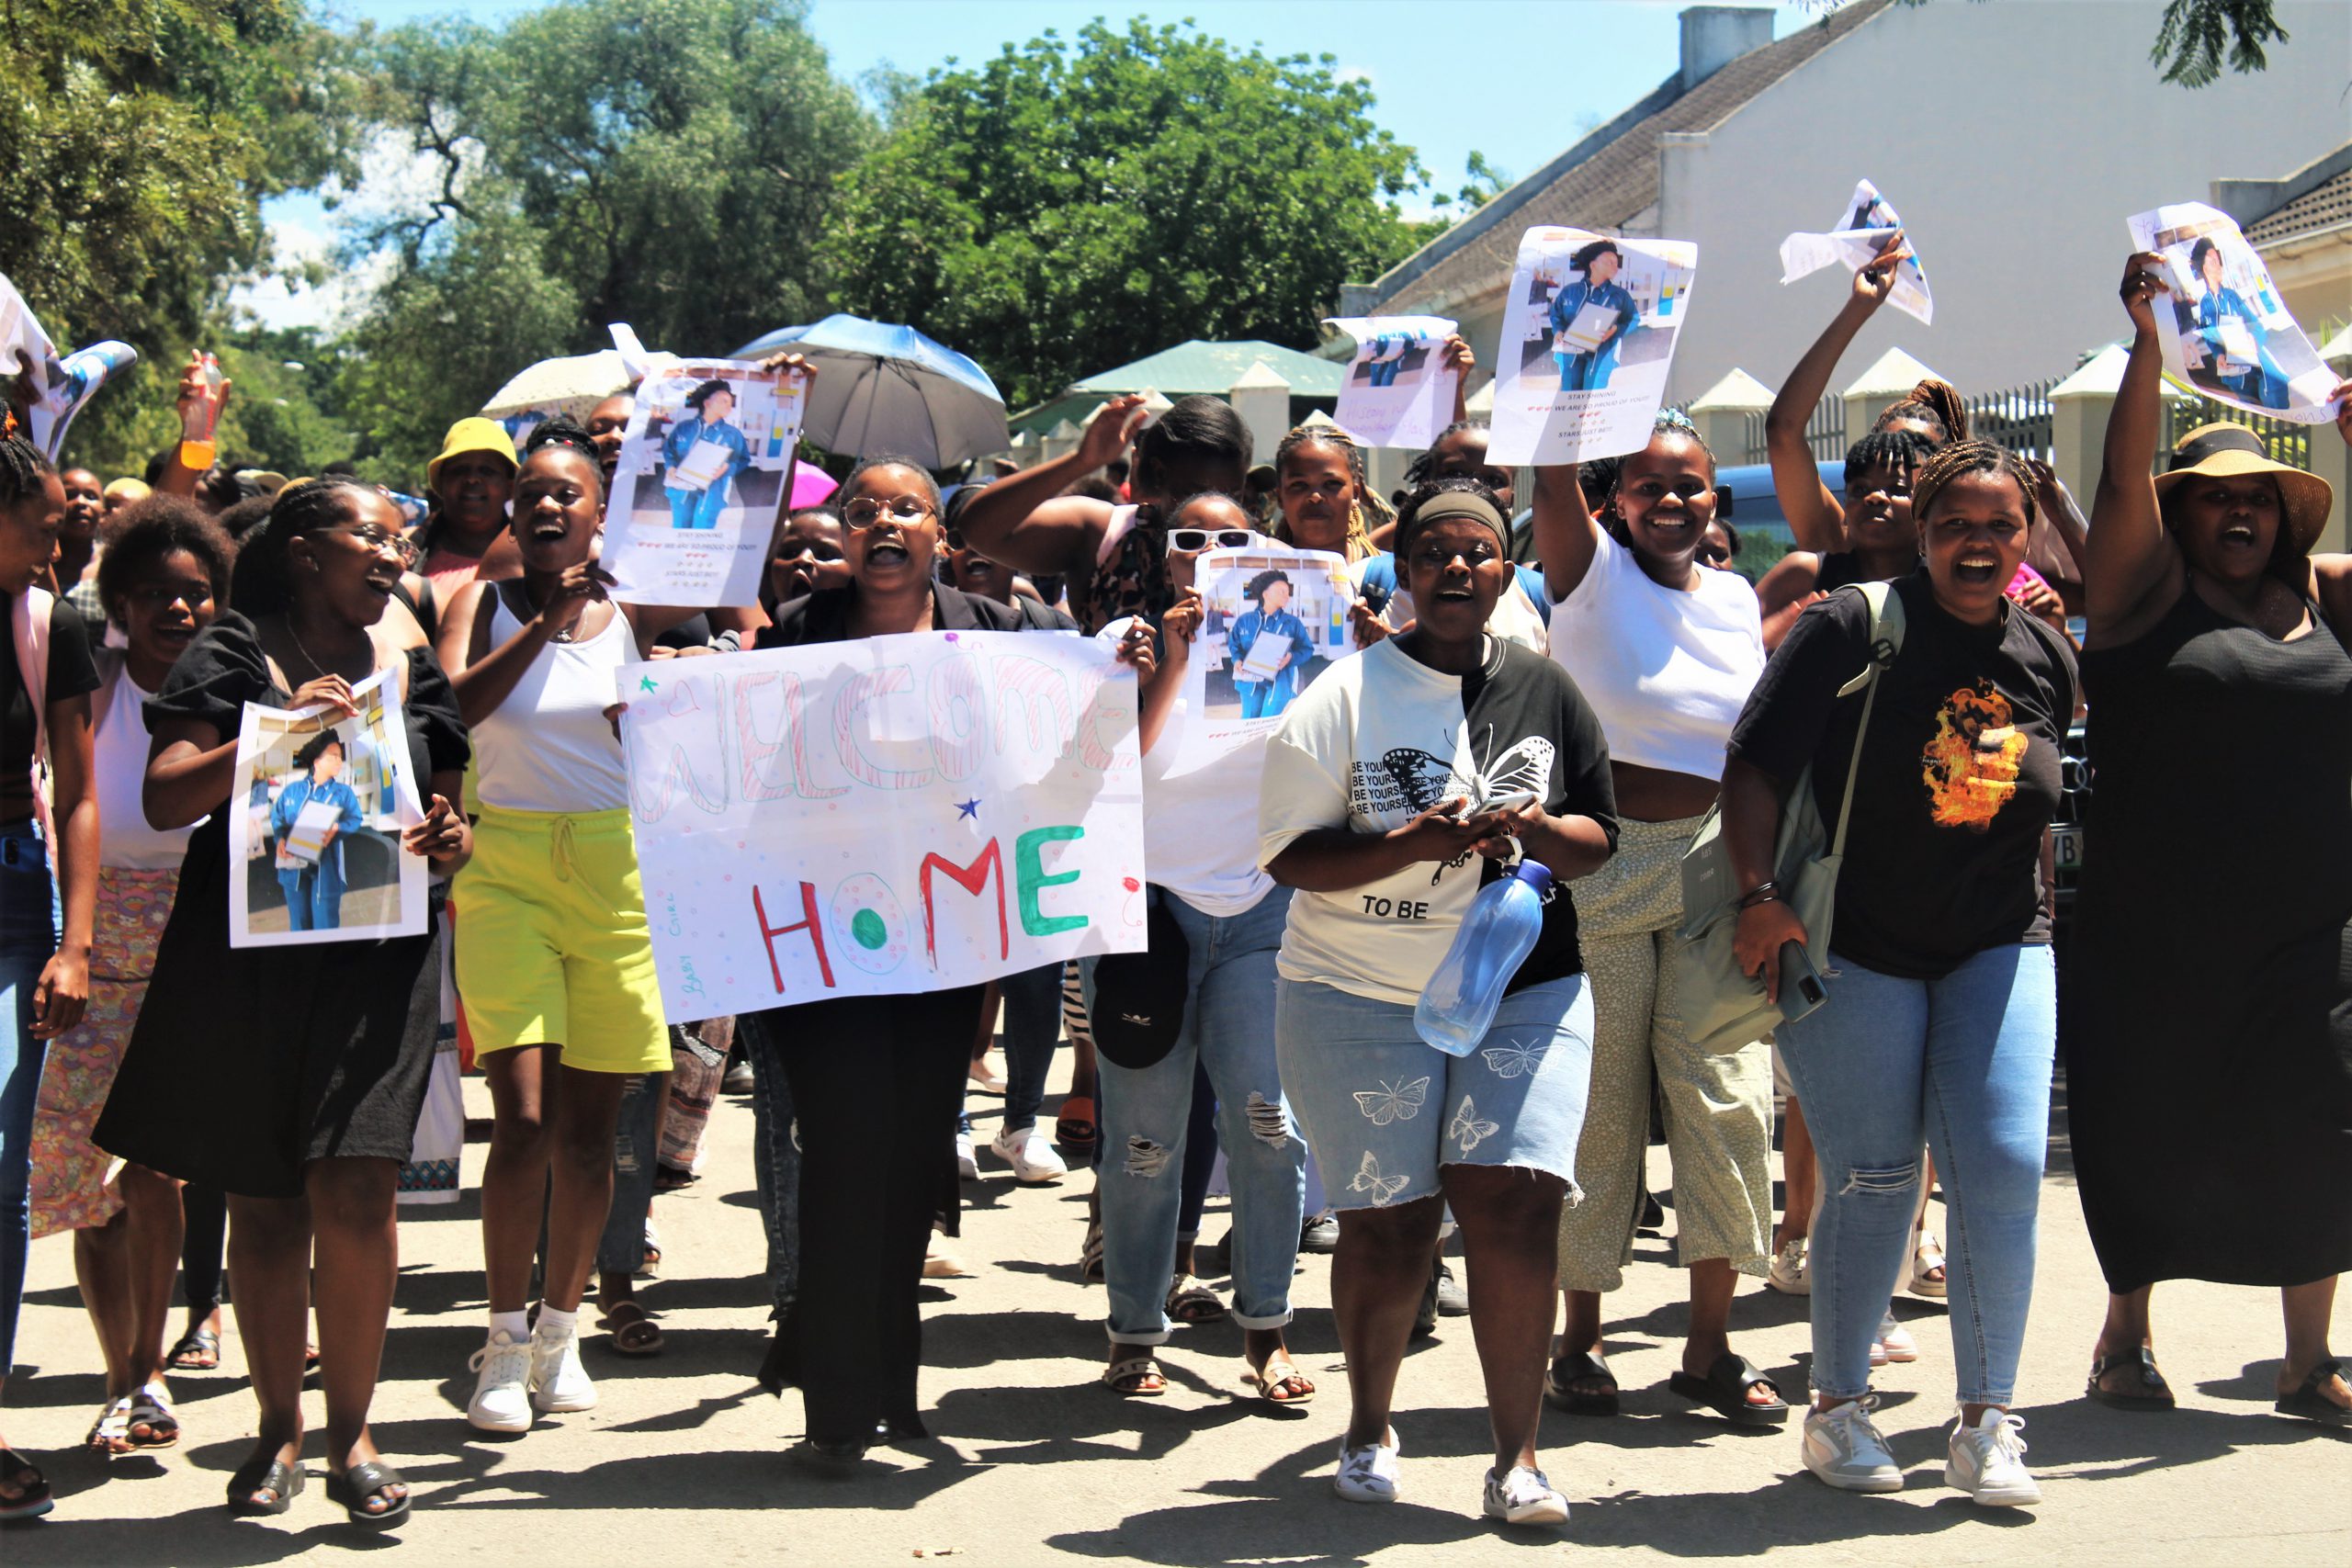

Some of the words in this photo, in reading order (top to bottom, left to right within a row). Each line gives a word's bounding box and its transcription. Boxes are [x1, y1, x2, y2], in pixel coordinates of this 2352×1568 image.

[1587, 390, 1617, 400] SHINING
[1583, 402, 1594, 411] SO
[1594, 399, 1619, 409] PROUD
[1558, 430, 1580, 438] STARS
[1581, 427, 1599, 435] JUST
[616, 649, 1138, 825] WELCOME
[1352, 776, 1365, 787] BE
[1354, 789, 1367, 801] BE
[1356, 802, 1369, 815] BE
[752, 825, 1089, 994] HOME
[1363, 895, 1392, 917] TO
[1396, 900, 1430, 919] BE
